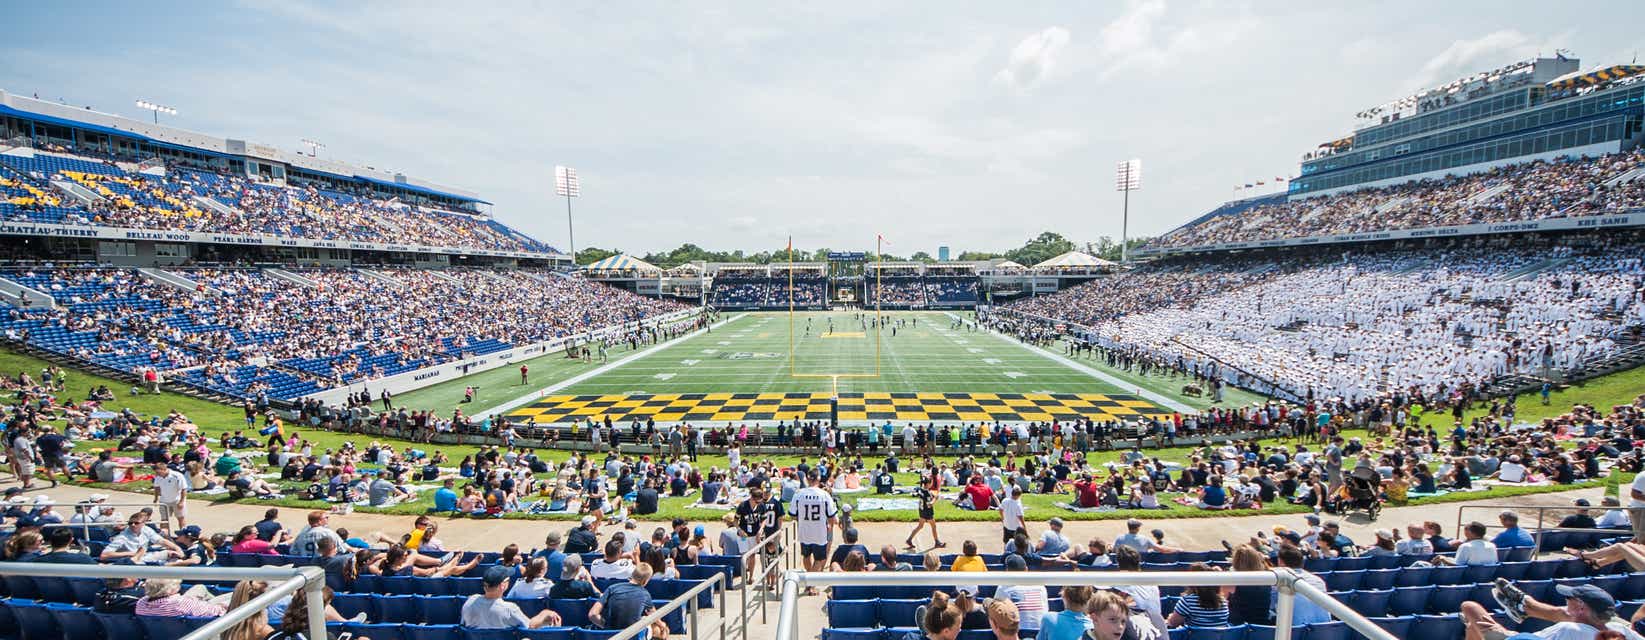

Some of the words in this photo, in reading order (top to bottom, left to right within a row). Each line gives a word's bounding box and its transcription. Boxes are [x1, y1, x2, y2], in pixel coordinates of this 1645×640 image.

[0, 225, 98, 237] CHATEAU-THIERRY
[126, 231, 162, 240] BELLEAU
[166, 233, 190, 241] WOOD
[880, 475, 891, 485] 12
[804, 504, 820, 521] 12
